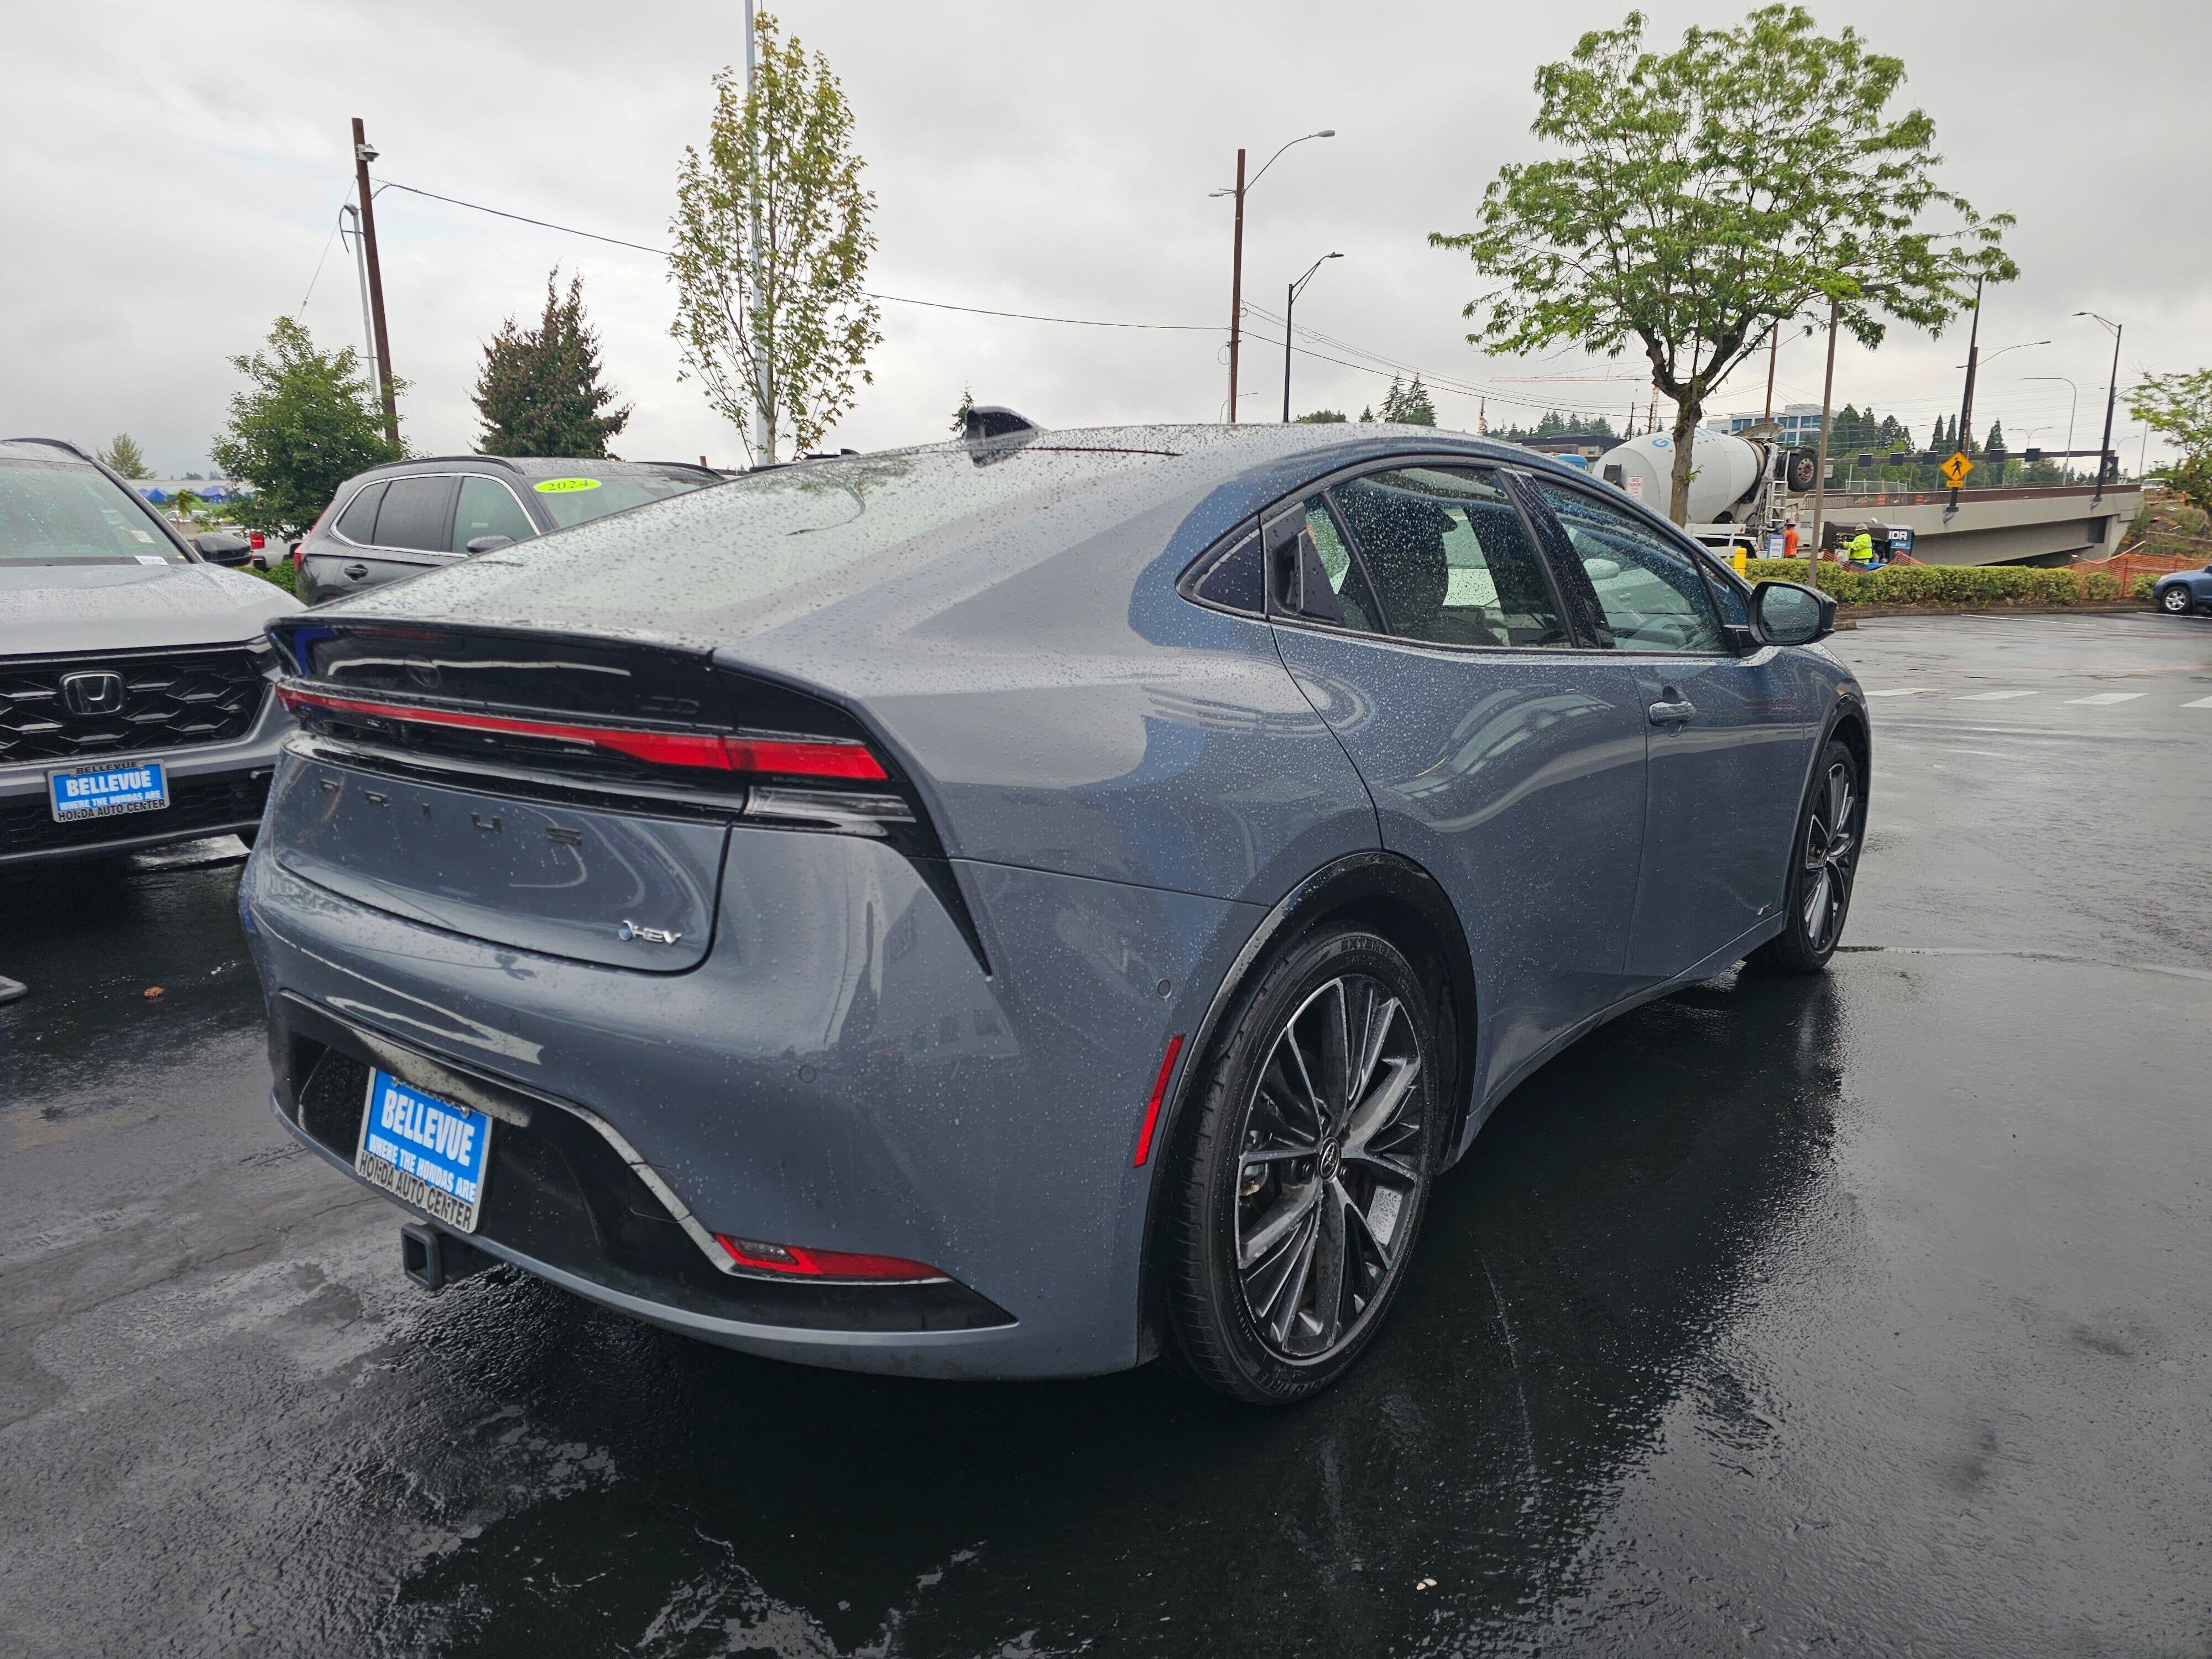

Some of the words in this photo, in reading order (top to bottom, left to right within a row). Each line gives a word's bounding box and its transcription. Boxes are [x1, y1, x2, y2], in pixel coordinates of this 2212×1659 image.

[547, 479, 589, 491] 2024
[76, 761, 138, 774] BELLEVUE
[66, 770, 152, 797] BELLEVUE
[58, 807, 95, 821] HONDA
[97, 804, 124, 817] AUTO
[127, 799, 166, 813] CENTER
[59, 799, 90, 811] WHERE
[92, 797, 108, 807] THE
[109, 792, 143, 805] HONDAS
[145, 790, 161, 799] ARE
[321, 779, 583, 847] PRIUS
[632, 925, 682, 945] HEV
[381, 1088, 475, 1167] BELLEVUE
[368, 1133, 398, 1165] WHERE
[399, 1149, 416, 1173] THE
[416, 1157, 454, 1193] HONDAS
[455, 1177, 477, 1203] ARE
[359, 1152, 394, 1187] HONDA
[396, 1170, 425, 1204] AUTO
[426, 1187, 473, 1231] CENTER
